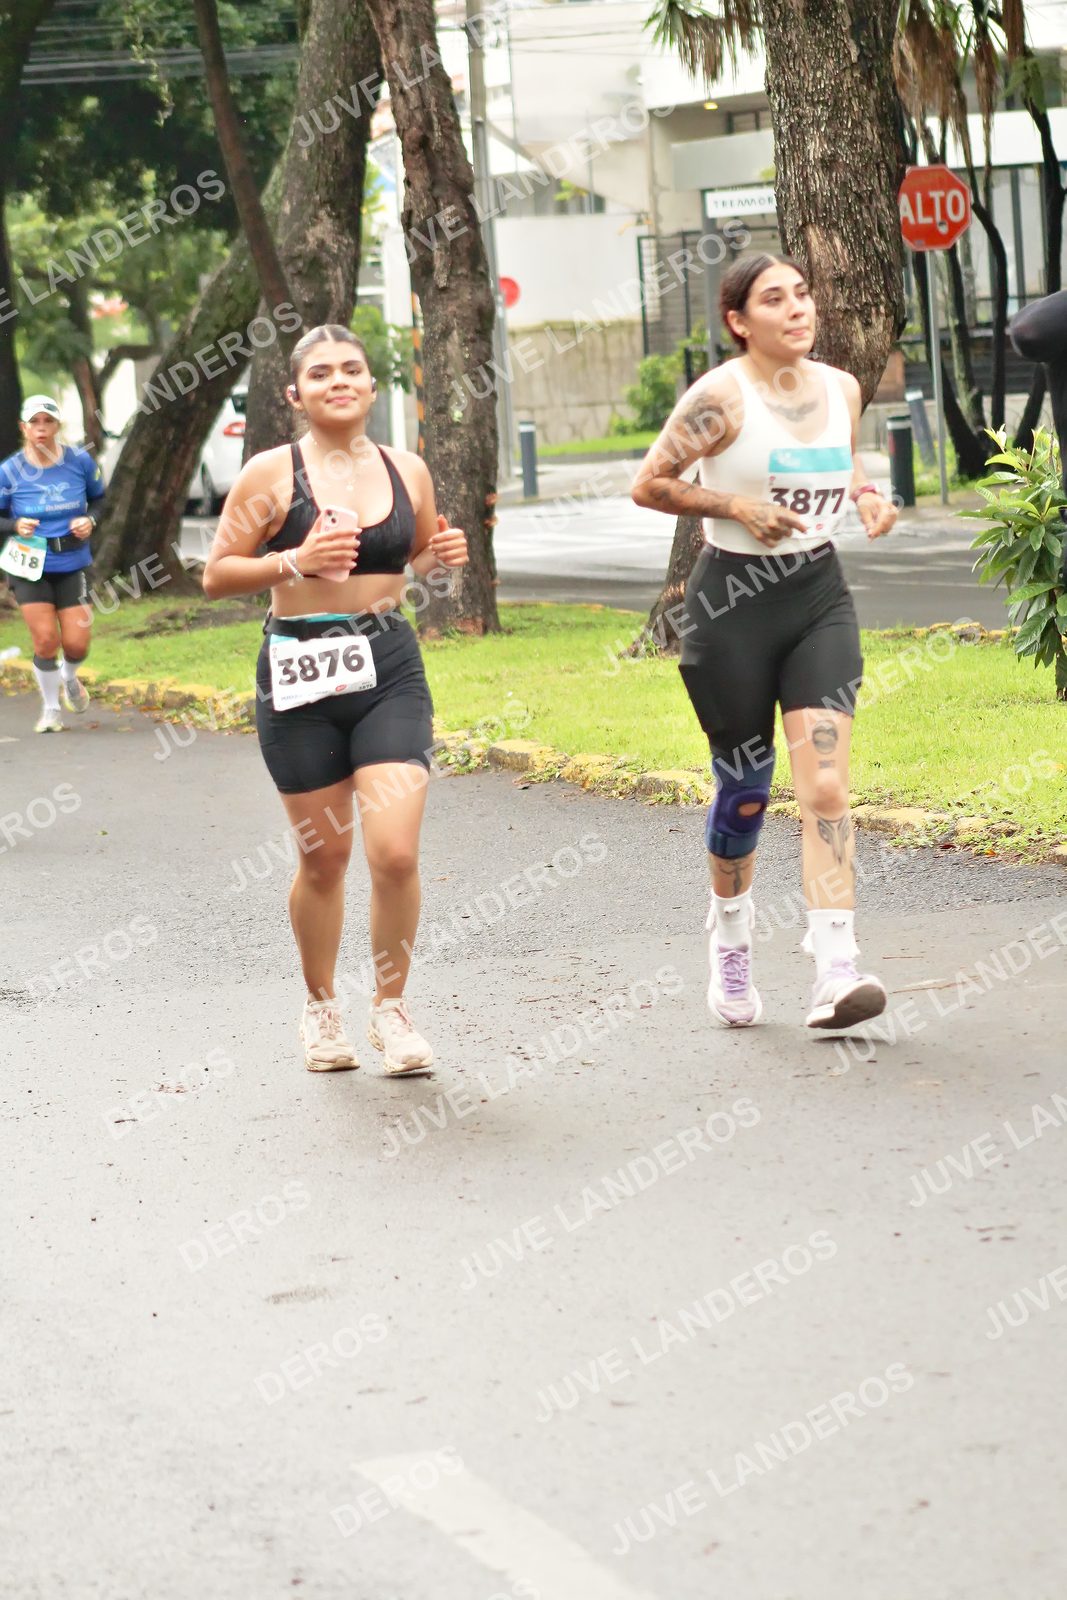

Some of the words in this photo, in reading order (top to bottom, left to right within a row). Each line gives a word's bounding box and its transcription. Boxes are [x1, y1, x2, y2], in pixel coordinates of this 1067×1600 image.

[900, 189, 966, 225] ALTO
[770, 487, 846, 516] 3877
[277, 645, 365, 686] 3876
